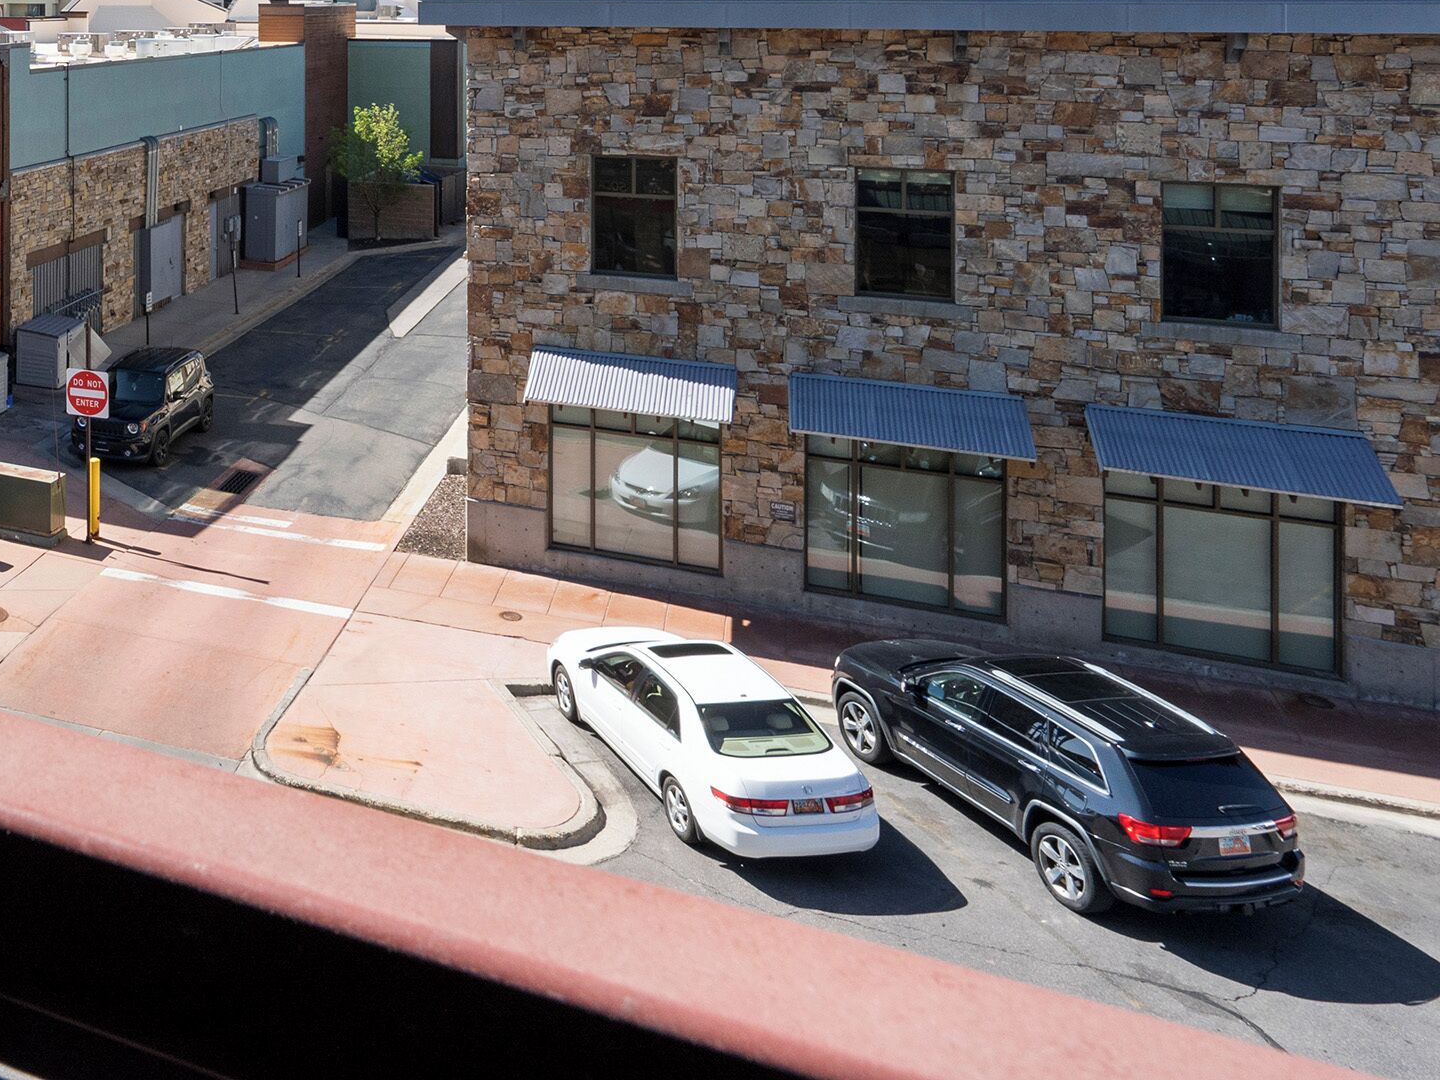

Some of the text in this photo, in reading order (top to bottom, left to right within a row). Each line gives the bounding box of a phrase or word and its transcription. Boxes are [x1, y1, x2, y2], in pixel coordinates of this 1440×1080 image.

[73, 378, 102, 388] DO NOT
[75, 398, 100, 408] ENTER
[771, 503, 794, 512] CAUTION
